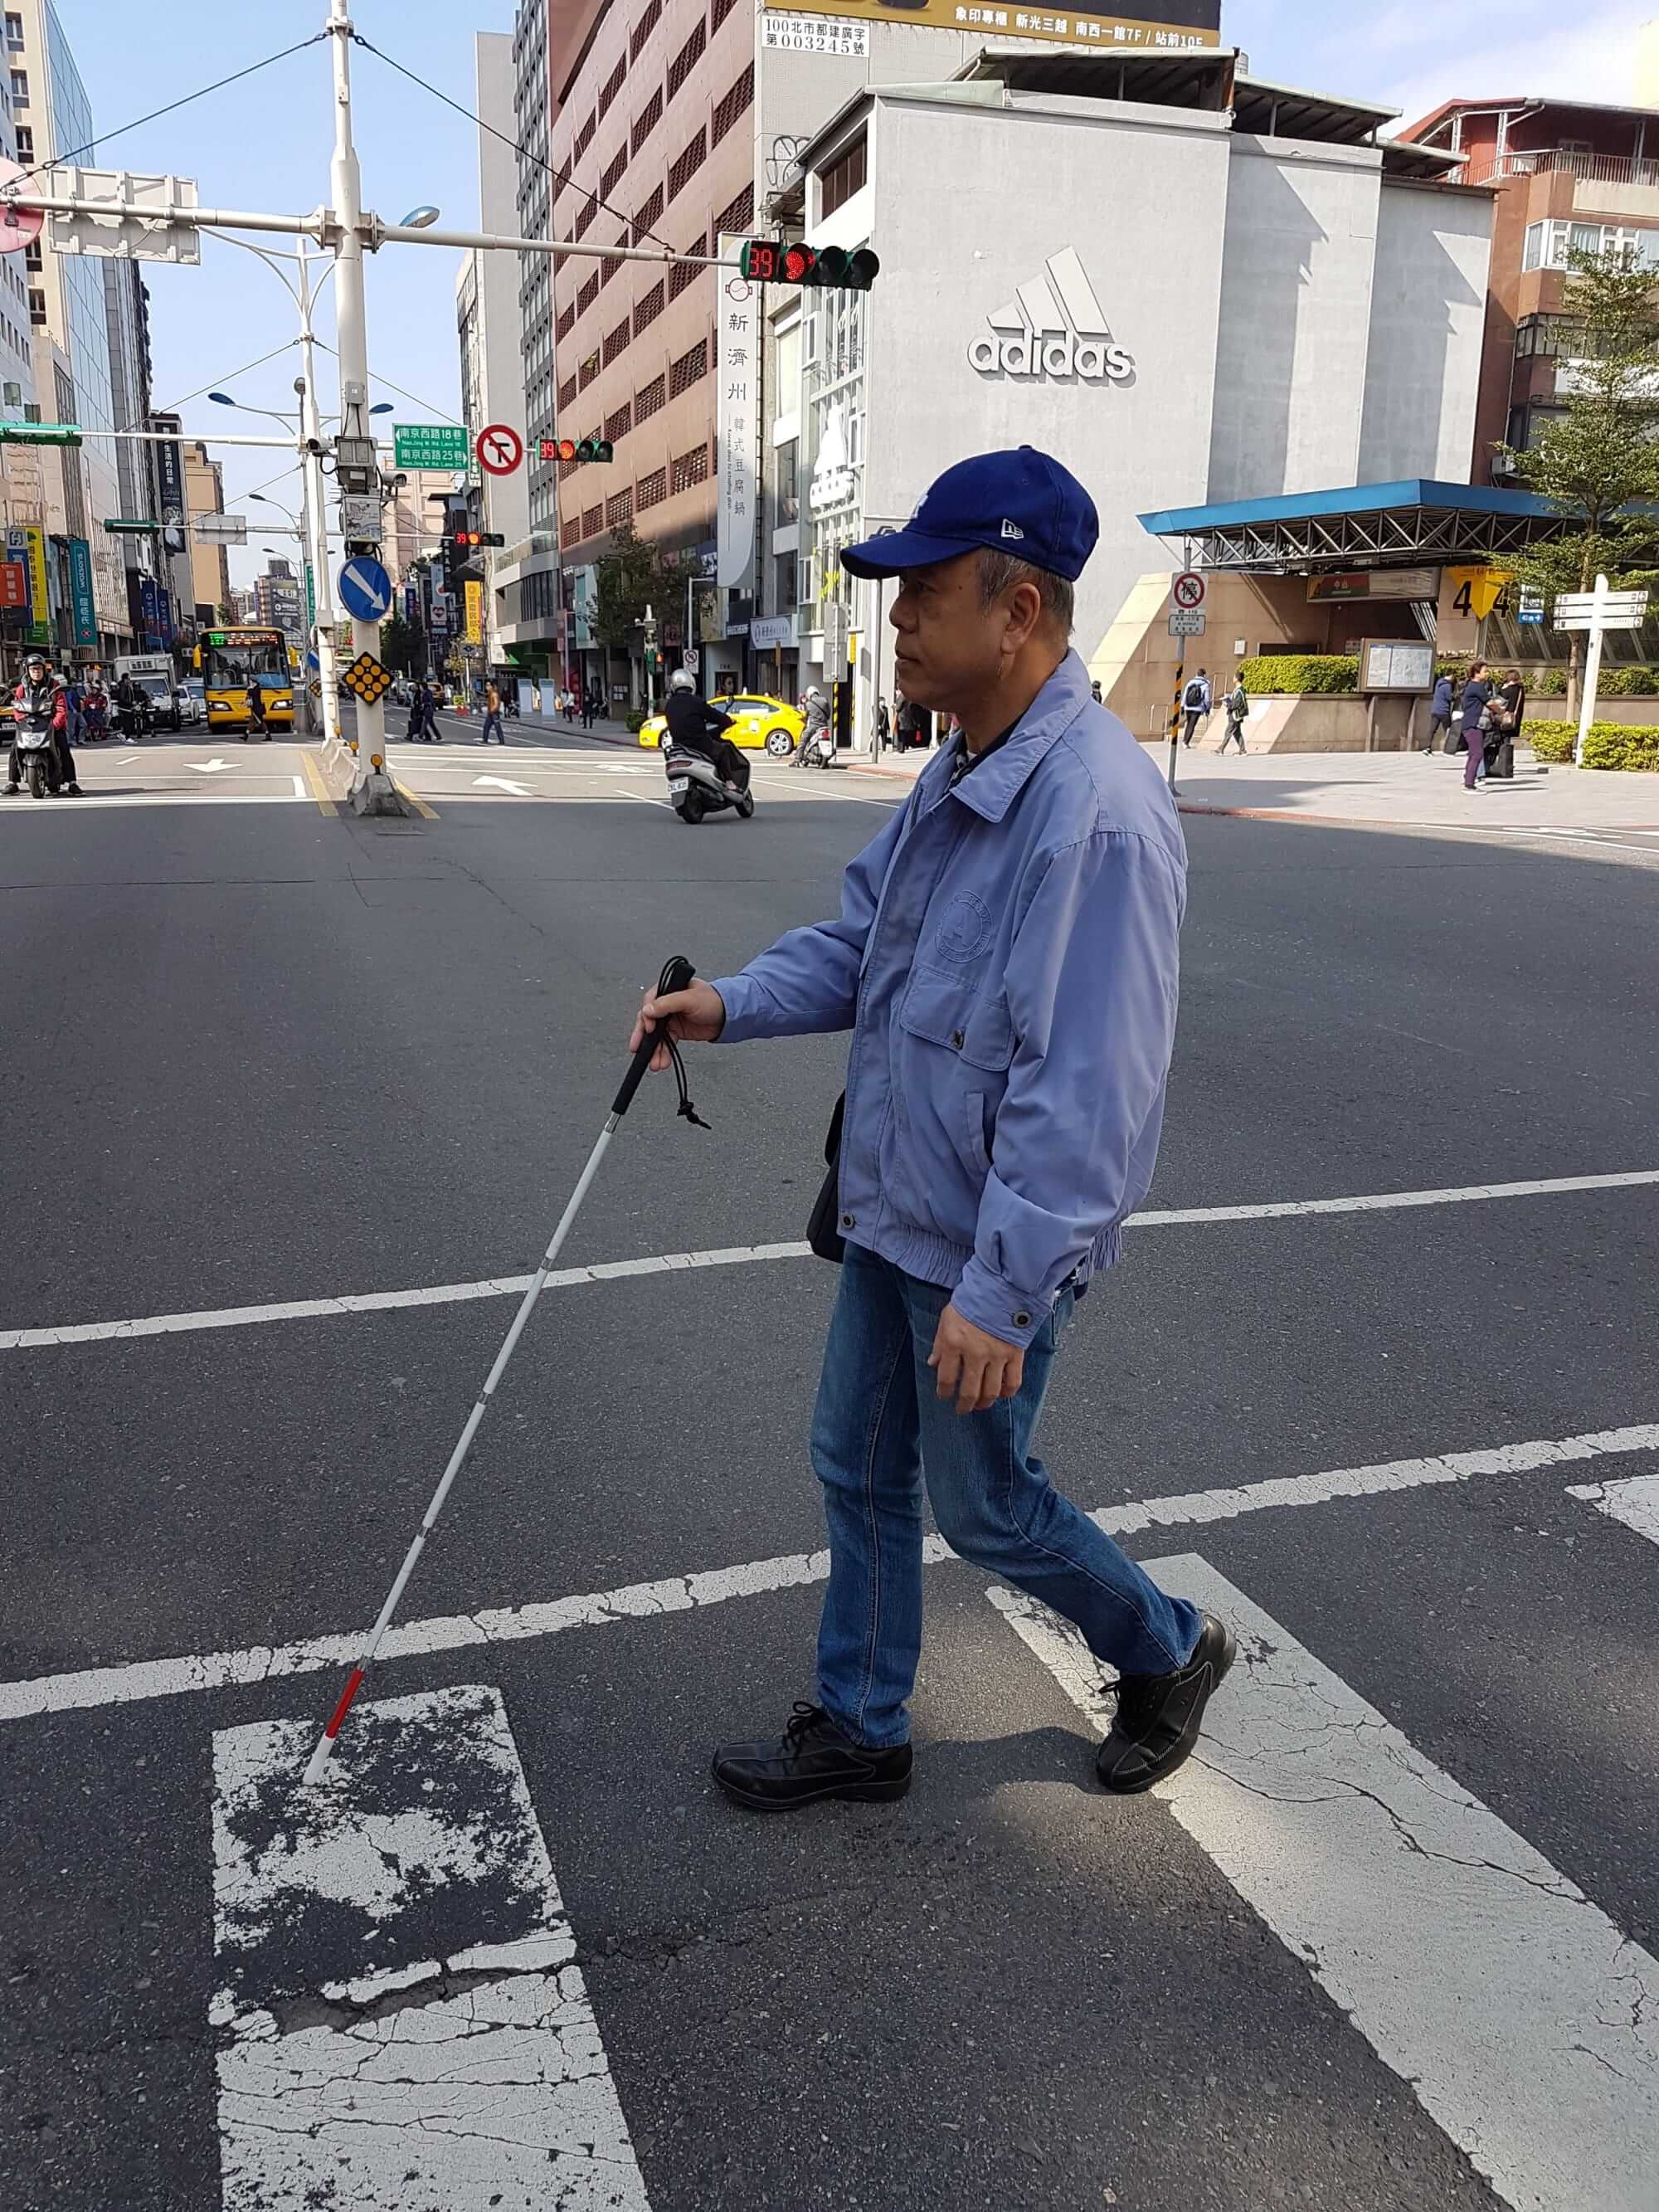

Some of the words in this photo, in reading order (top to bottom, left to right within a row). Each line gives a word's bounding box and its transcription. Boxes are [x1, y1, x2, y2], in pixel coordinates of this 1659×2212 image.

[955, 6, 1007, 27] 象印專櫃
[1015, 13, 1068, 34] 新光三越
[1075, 21, 1141, 41] 南西一館7F
[766, 33, 864, 56] 第003245號
[750, 248, 772, 278] 39
[727, 312, 749, 401] 新濟州
[967, 329, 1131, 379] adidas
[400, 427, 462, 441] 南京西路18巷
[401, 448, 463, 461] 南京西路25巷
[541, 442, 554, 458] 39
[457, 533, 466, 543] 39
[1453, 581, 1472, 617] 4
[1493, 582, 1510, 618] 4
